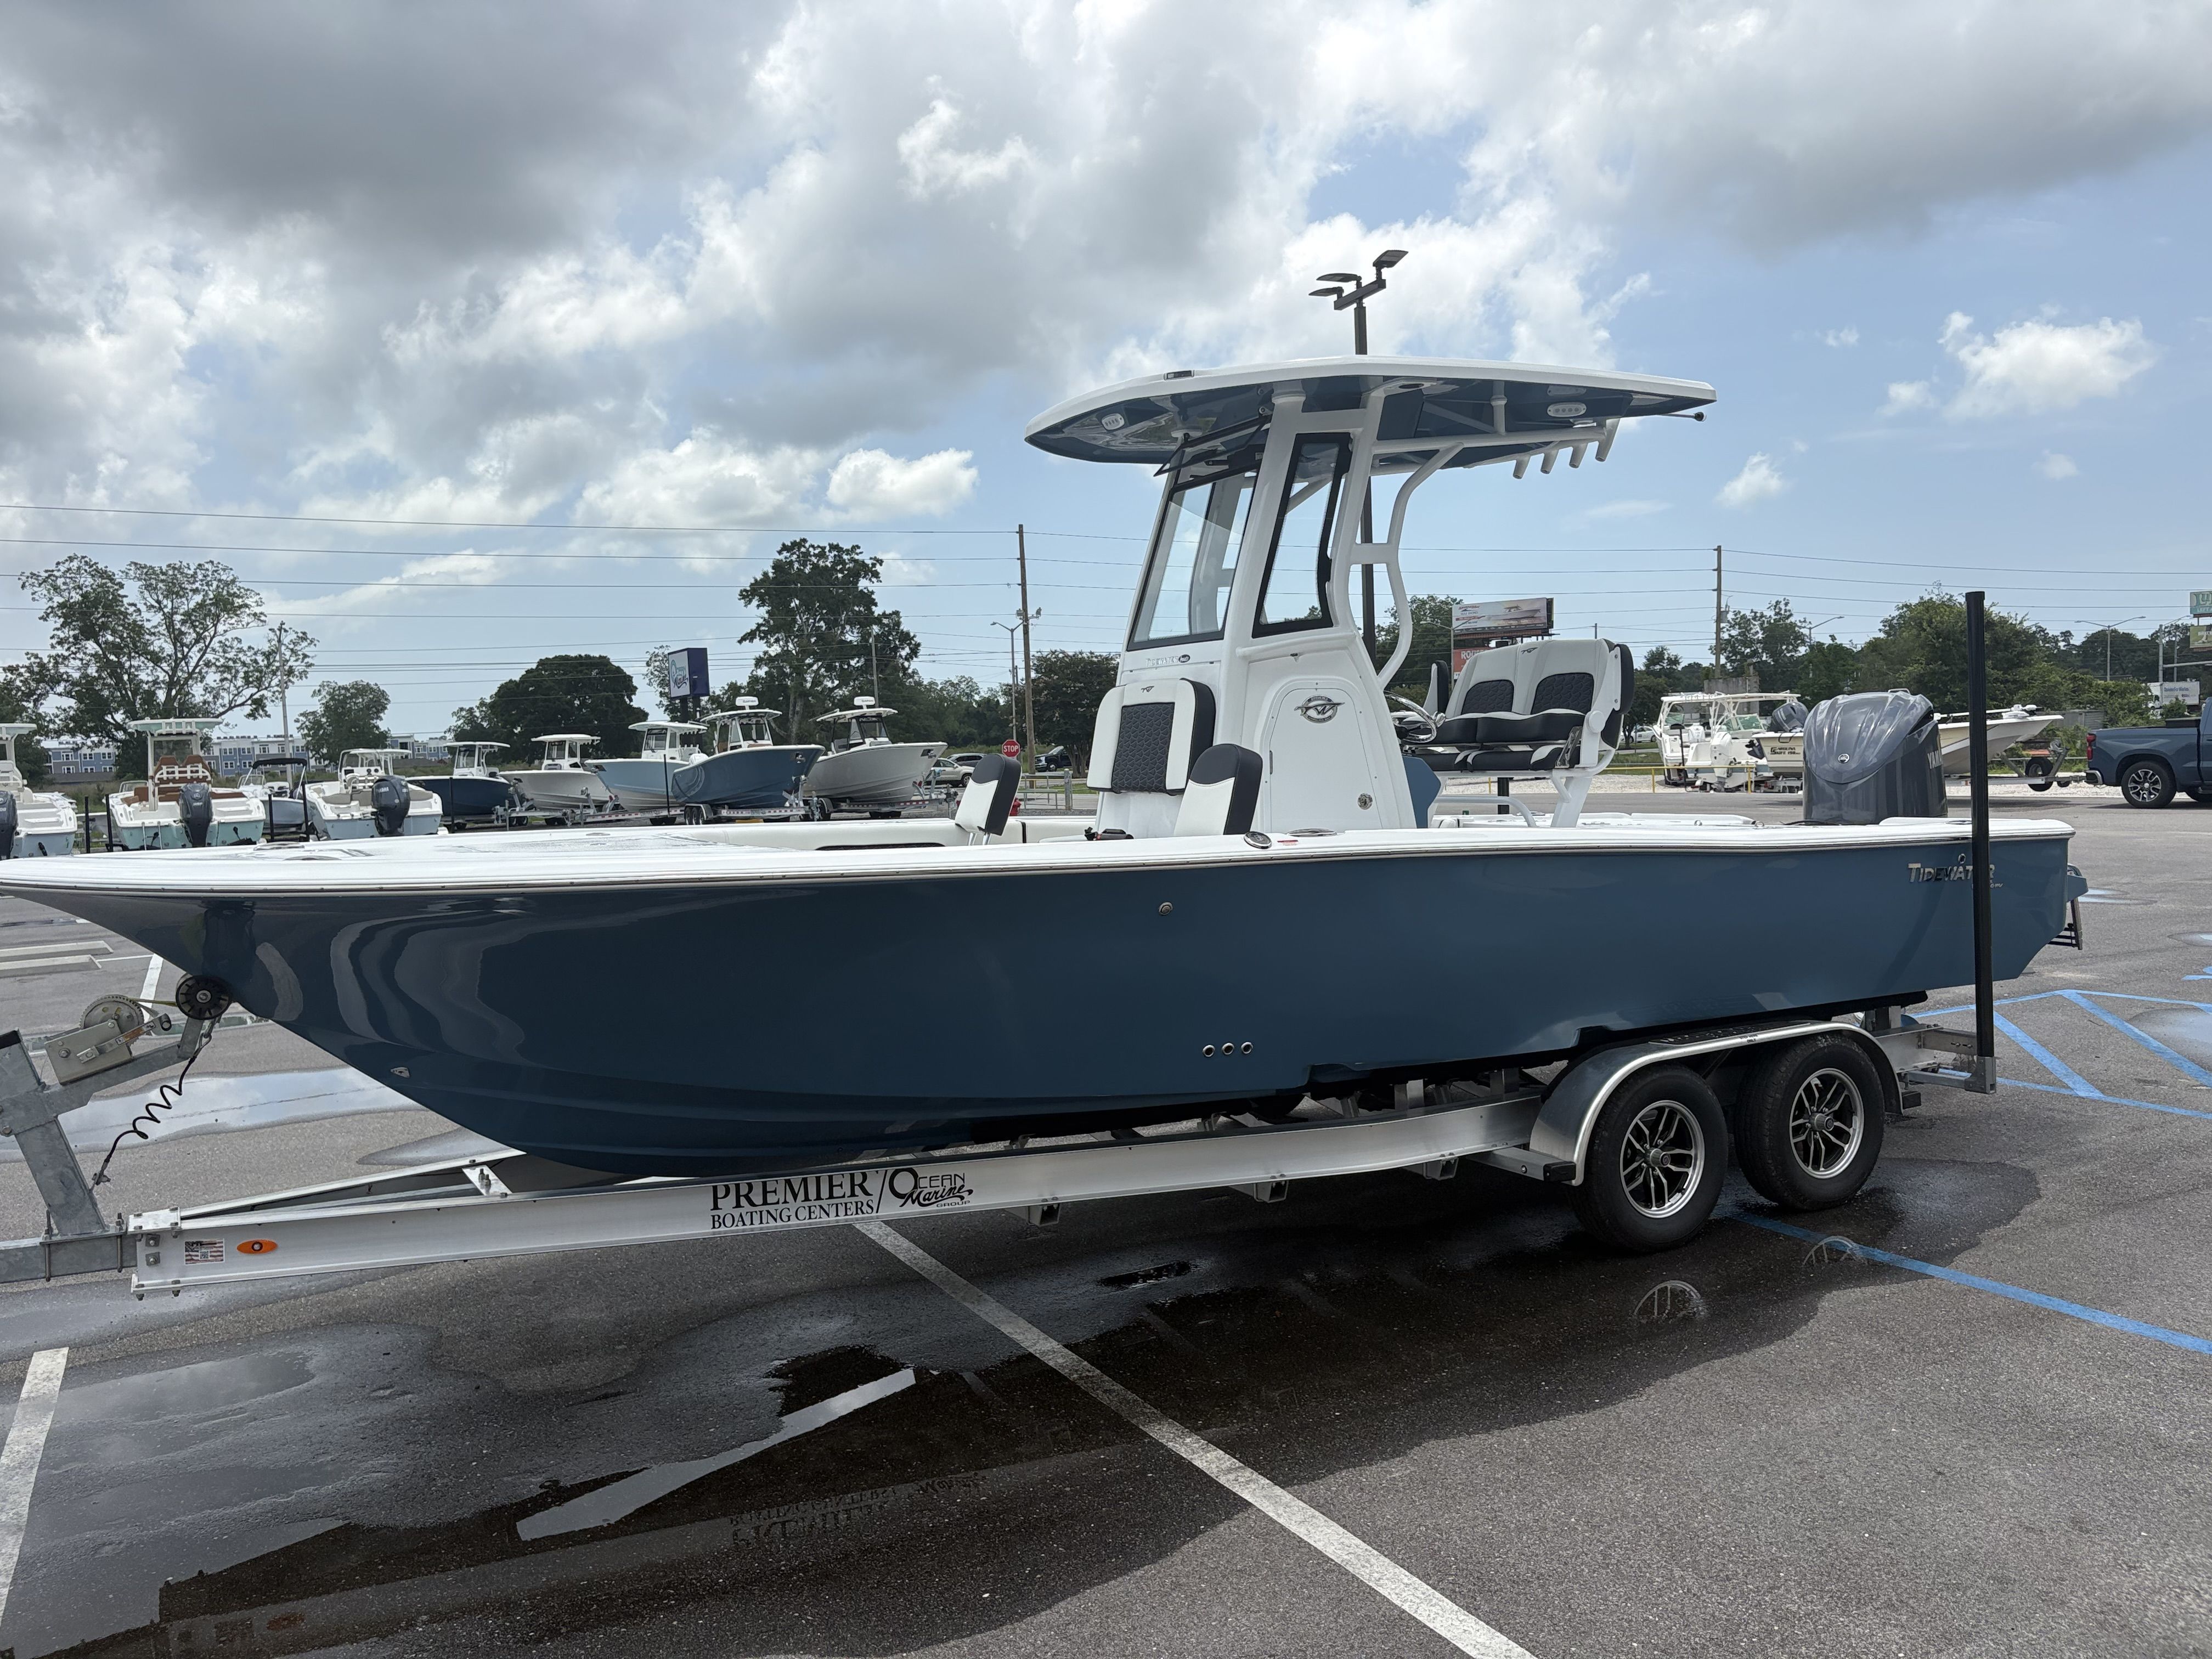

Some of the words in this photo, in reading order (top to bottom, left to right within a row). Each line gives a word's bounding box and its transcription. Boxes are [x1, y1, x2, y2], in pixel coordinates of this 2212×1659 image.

[1908, 863, 1996, 883] TIDEWATR
[710, 1171, 873, 1211] PREMIER
[888, 1167, 965, 1200] OCEAN
[899, 1183, 974, 1207] Marine
[710, 1208, 792, 1229] BOATING
[795, 1199, 874, 1221] CENTERS
